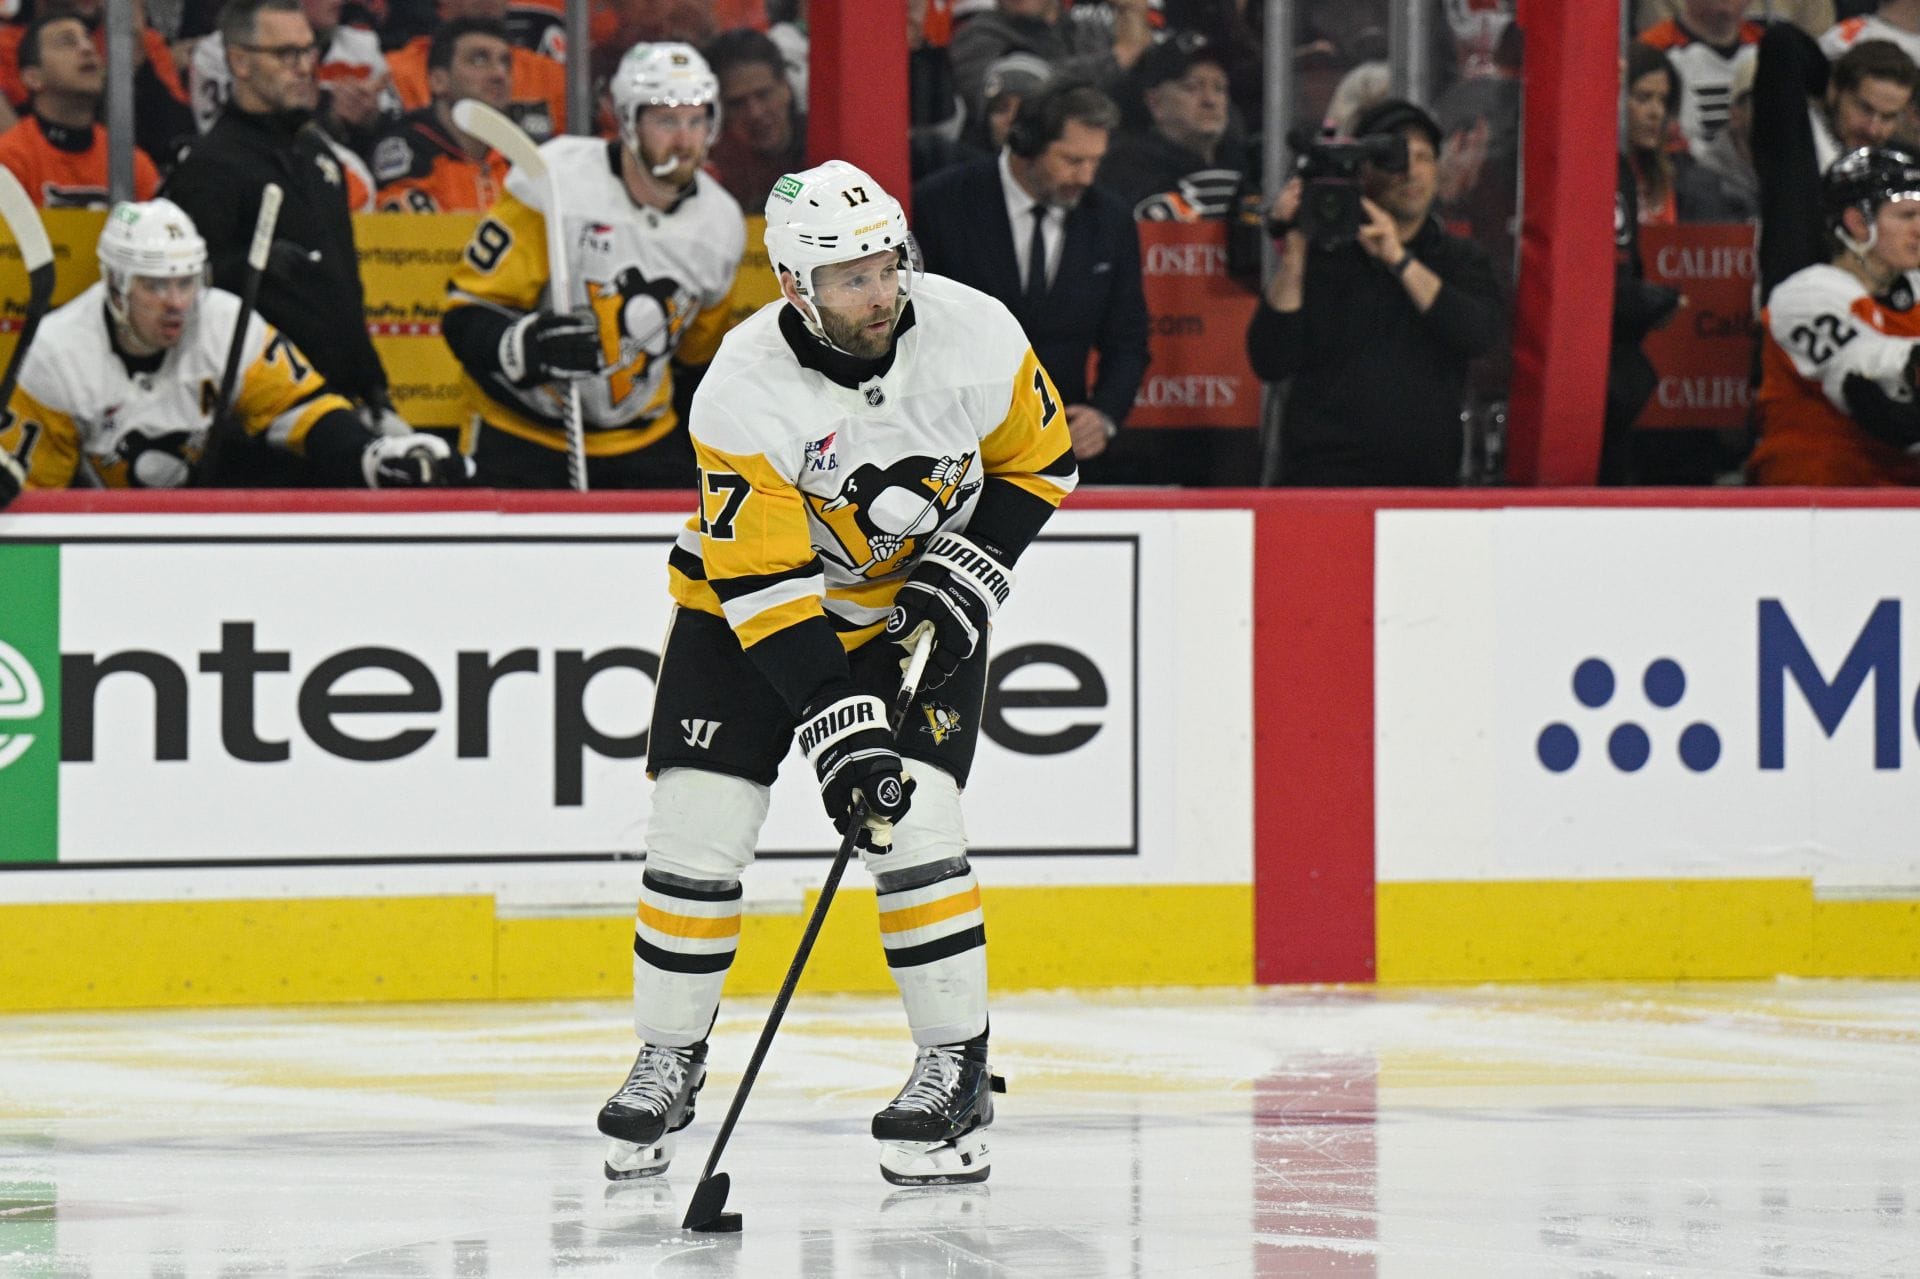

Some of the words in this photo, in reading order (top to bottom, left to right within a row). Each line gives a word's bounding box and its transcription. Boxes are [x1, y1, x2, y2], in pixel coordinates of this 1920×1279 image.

[841, 186, 870, 207] 17
[467, 218, 512, 272] 9
[854, 220, 889, 236] BAUER
[1789, 315, 1859, 365] 22
[1757, 597, 1920, 770] M
